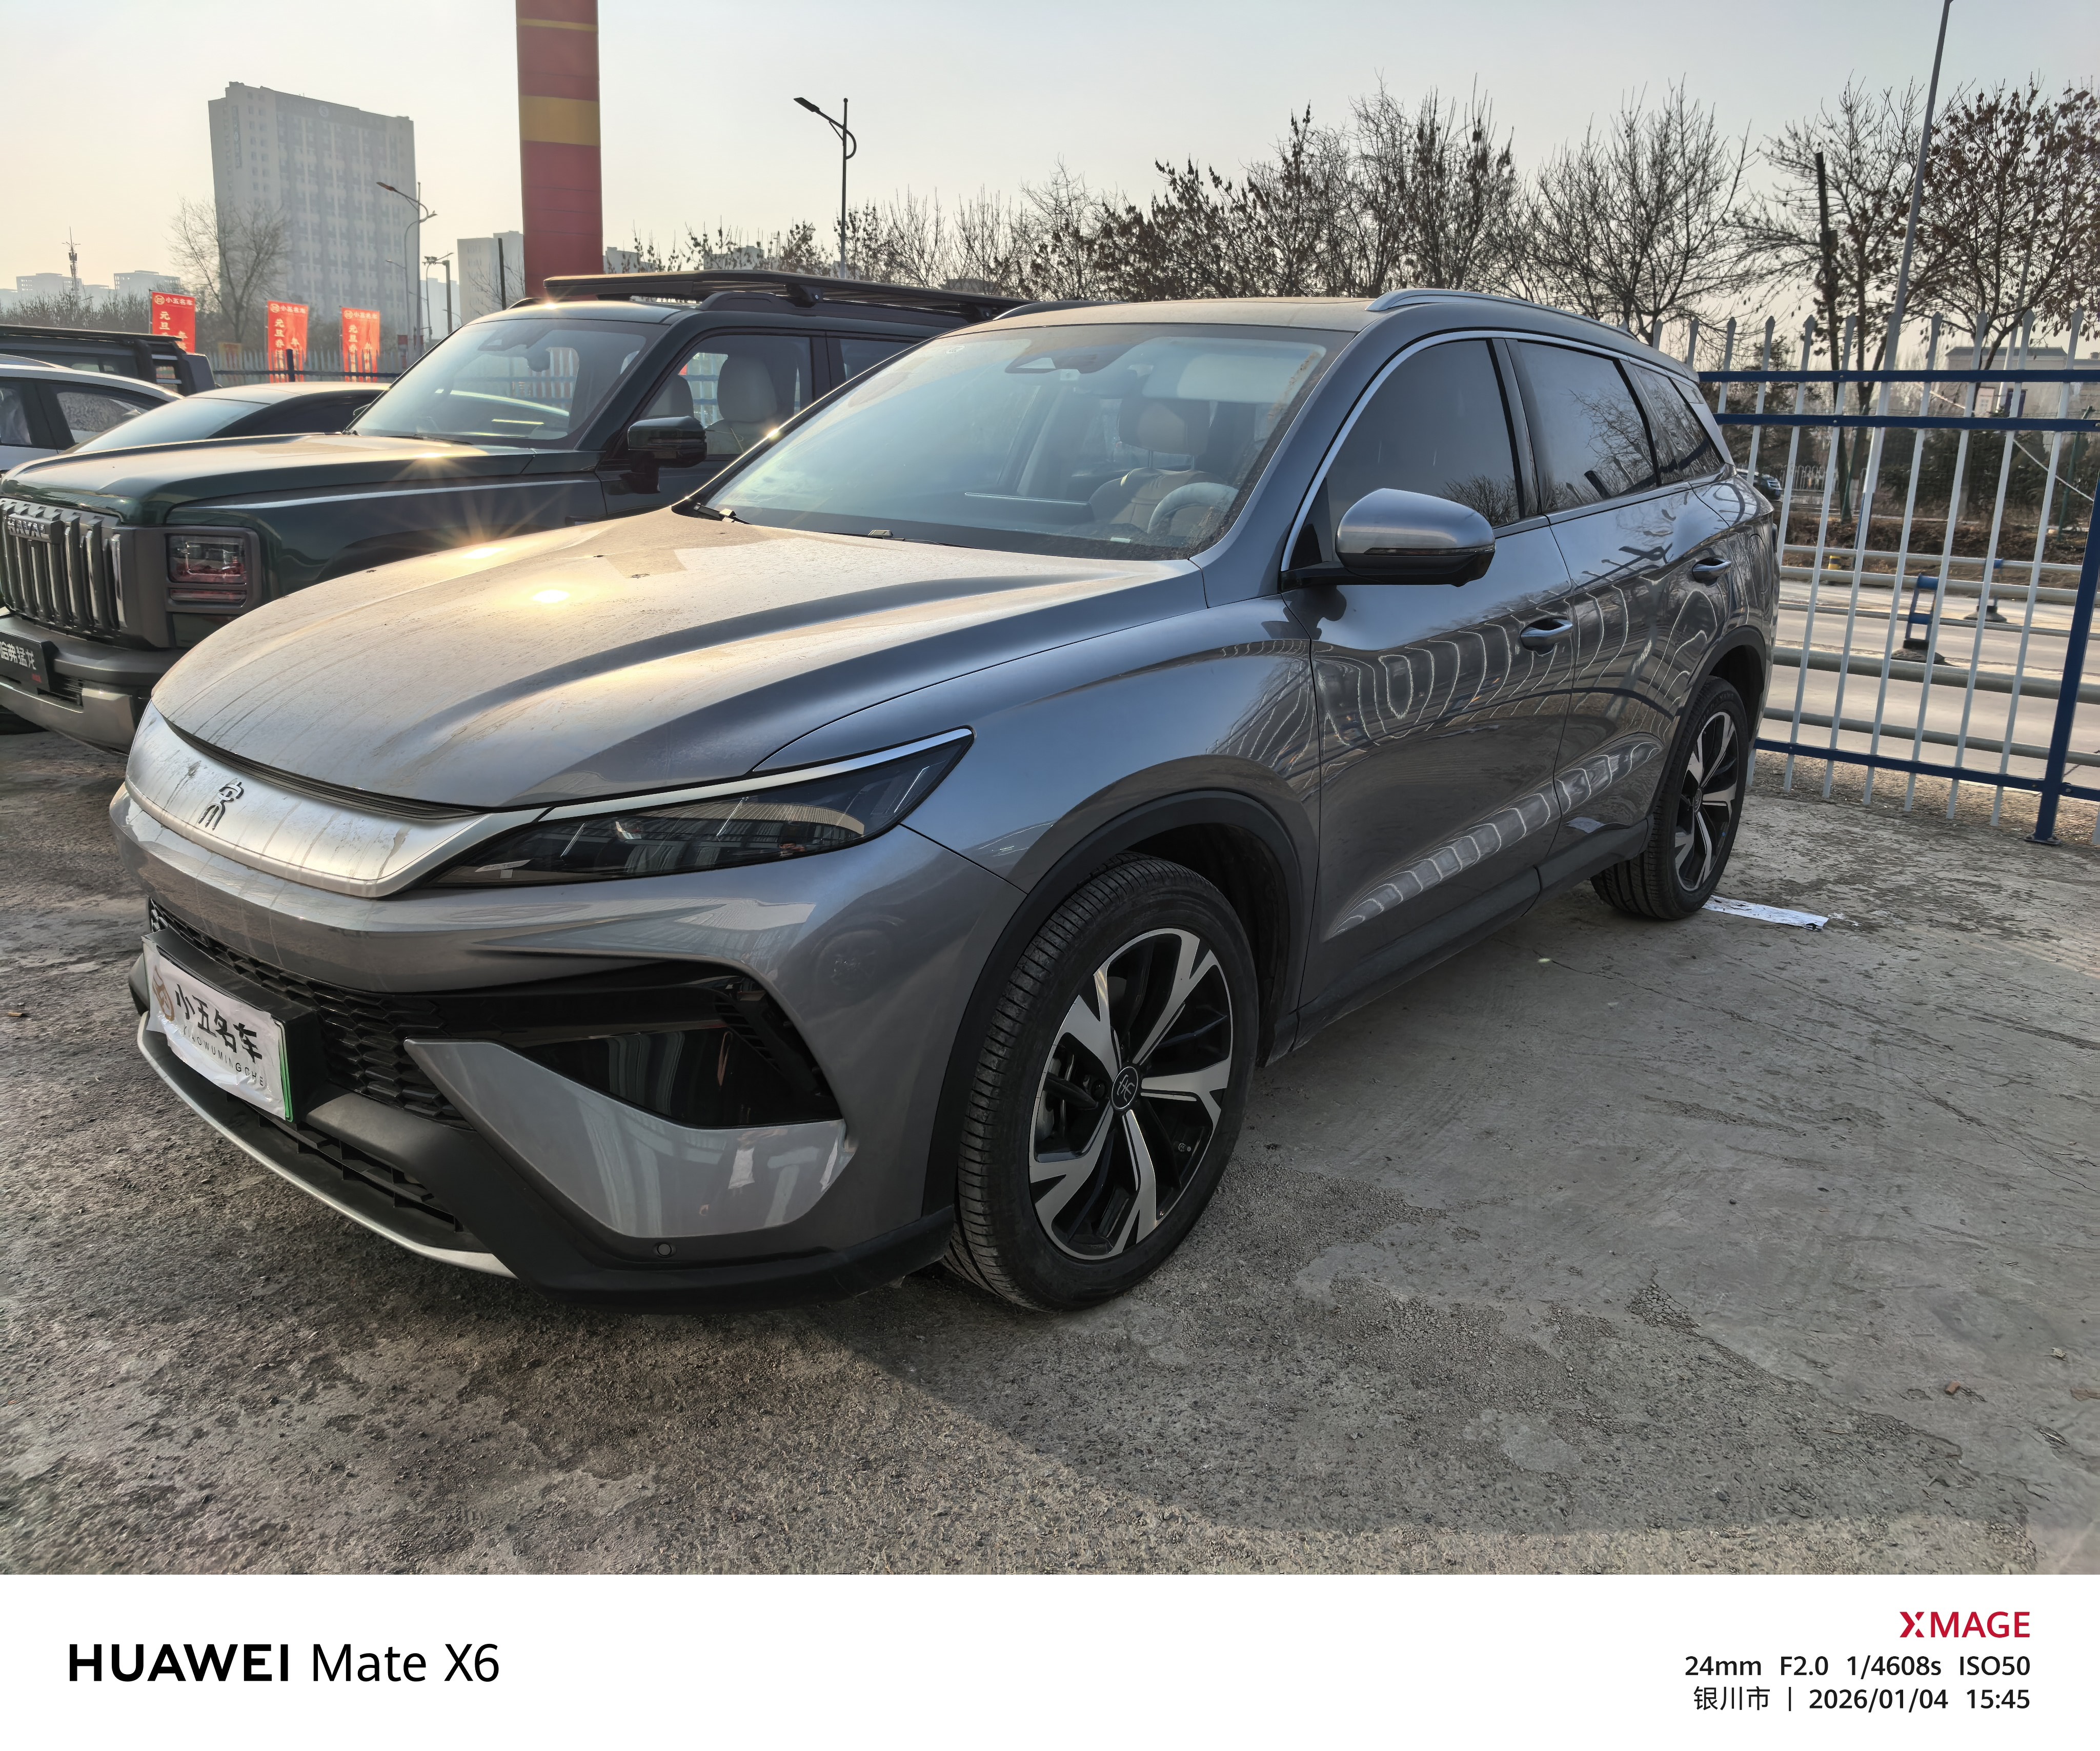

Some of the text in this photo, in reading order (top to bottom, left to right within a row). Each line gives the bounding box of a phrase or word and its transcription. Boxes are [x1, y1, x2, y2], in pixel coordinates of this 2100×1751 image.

[165, 296, 194, 306] 小五名车
[174, 983, 262, 1064] 小五名车
